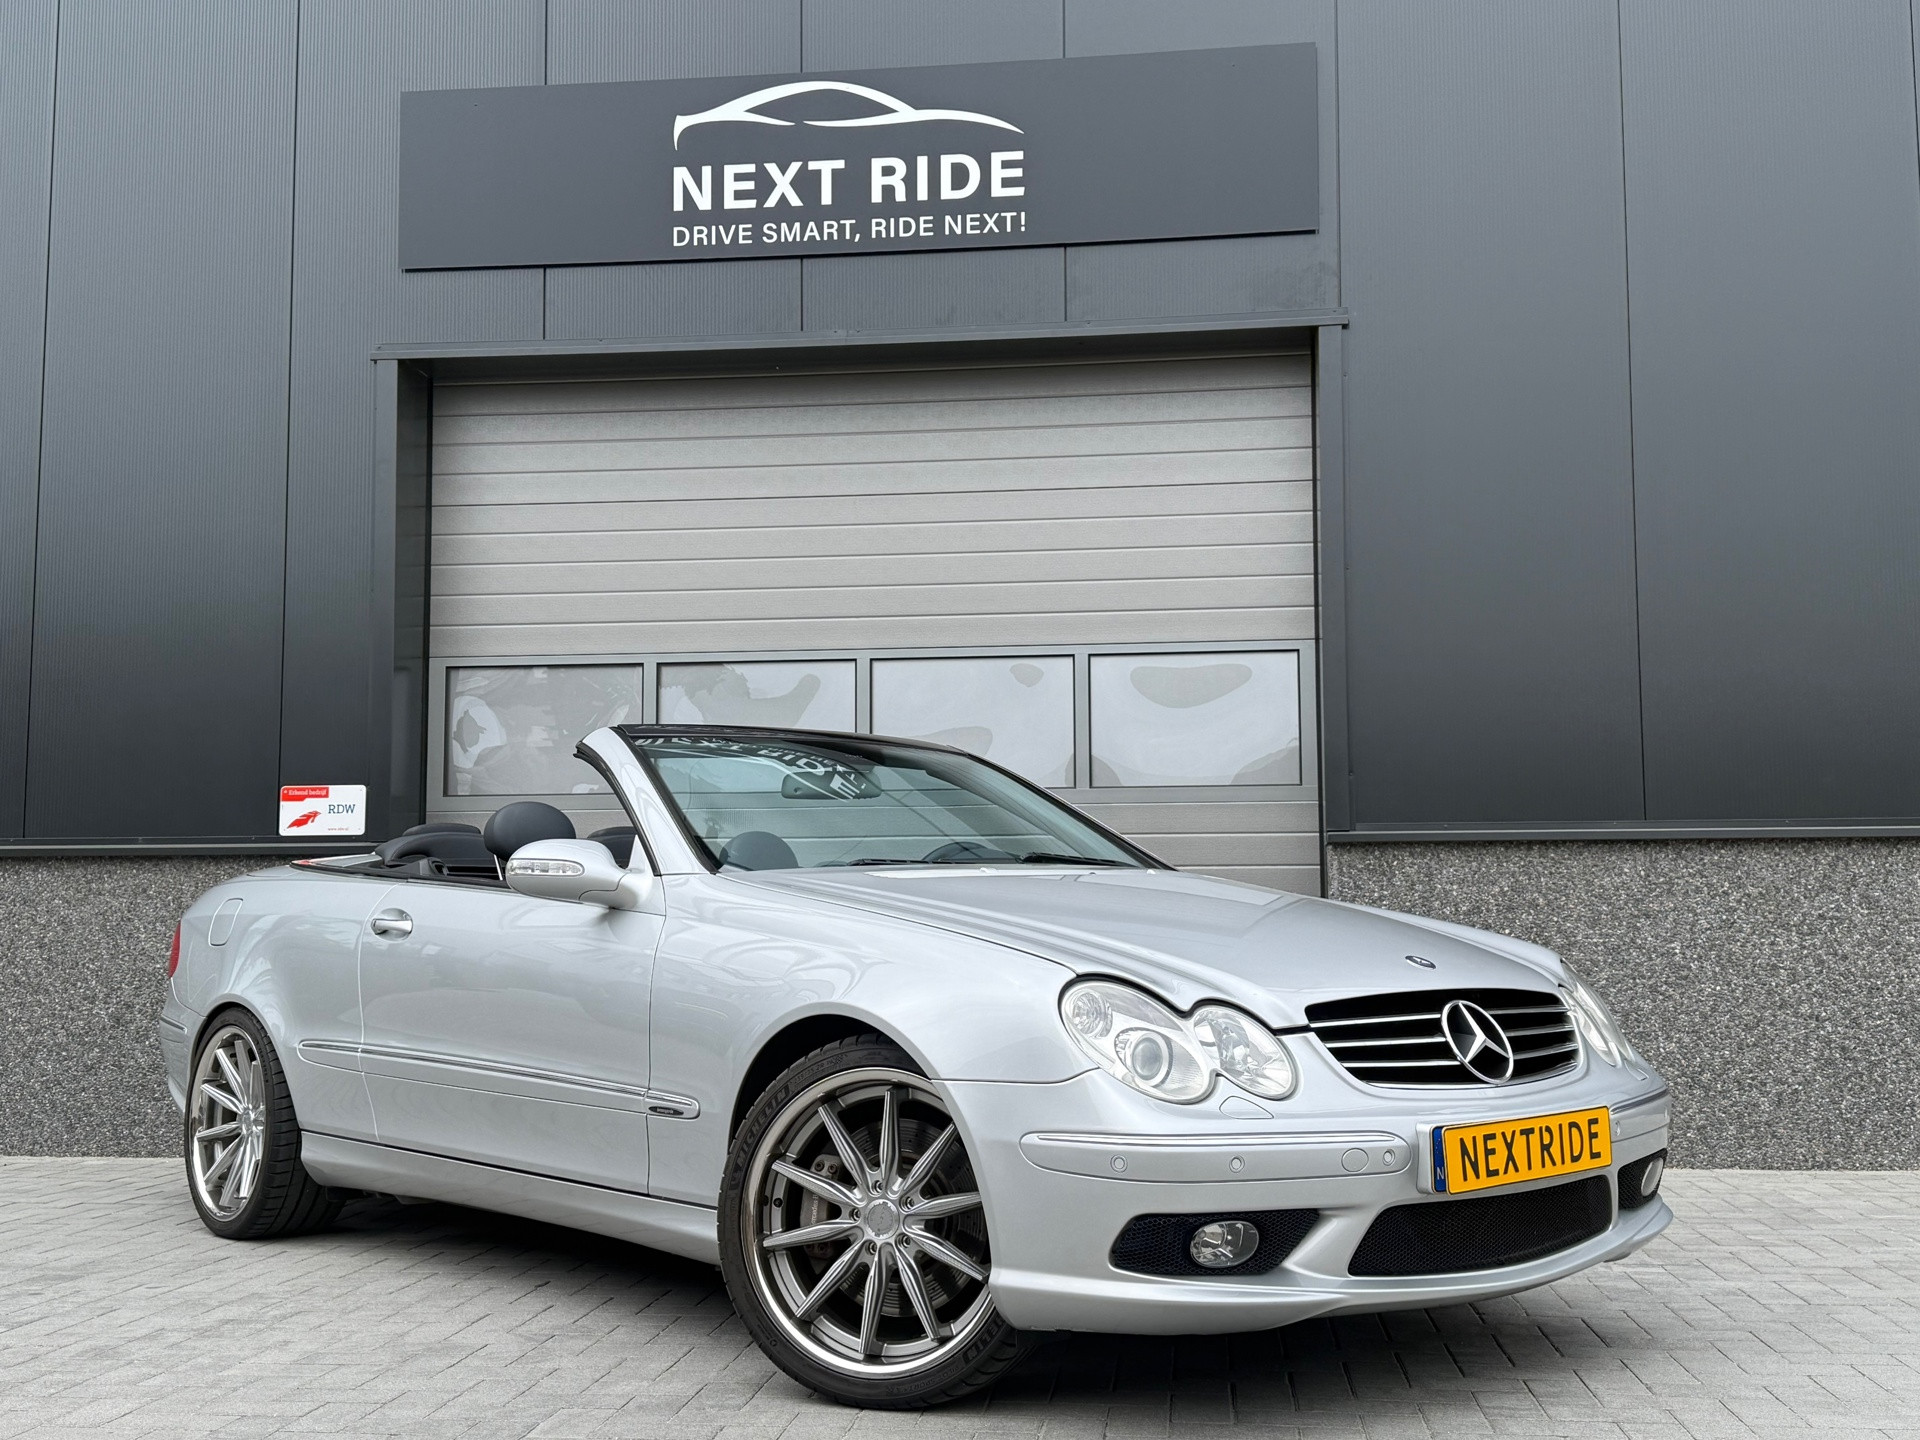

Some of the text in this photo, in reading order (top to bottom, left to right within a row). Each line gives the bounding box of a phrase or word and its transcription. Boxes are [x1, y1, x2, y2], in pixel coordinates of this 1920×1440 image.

[673, 150, 1025, 212] NEXT RIDE
[673, 212, 1027, 247] DRIVE SMART, RIDE NEXT!
[328, 804, 355, 814] RDW
[735, 1086, 788, 1168] MICHELIN
[1460, 1117, 1601, 1182] NEXTRIDE
